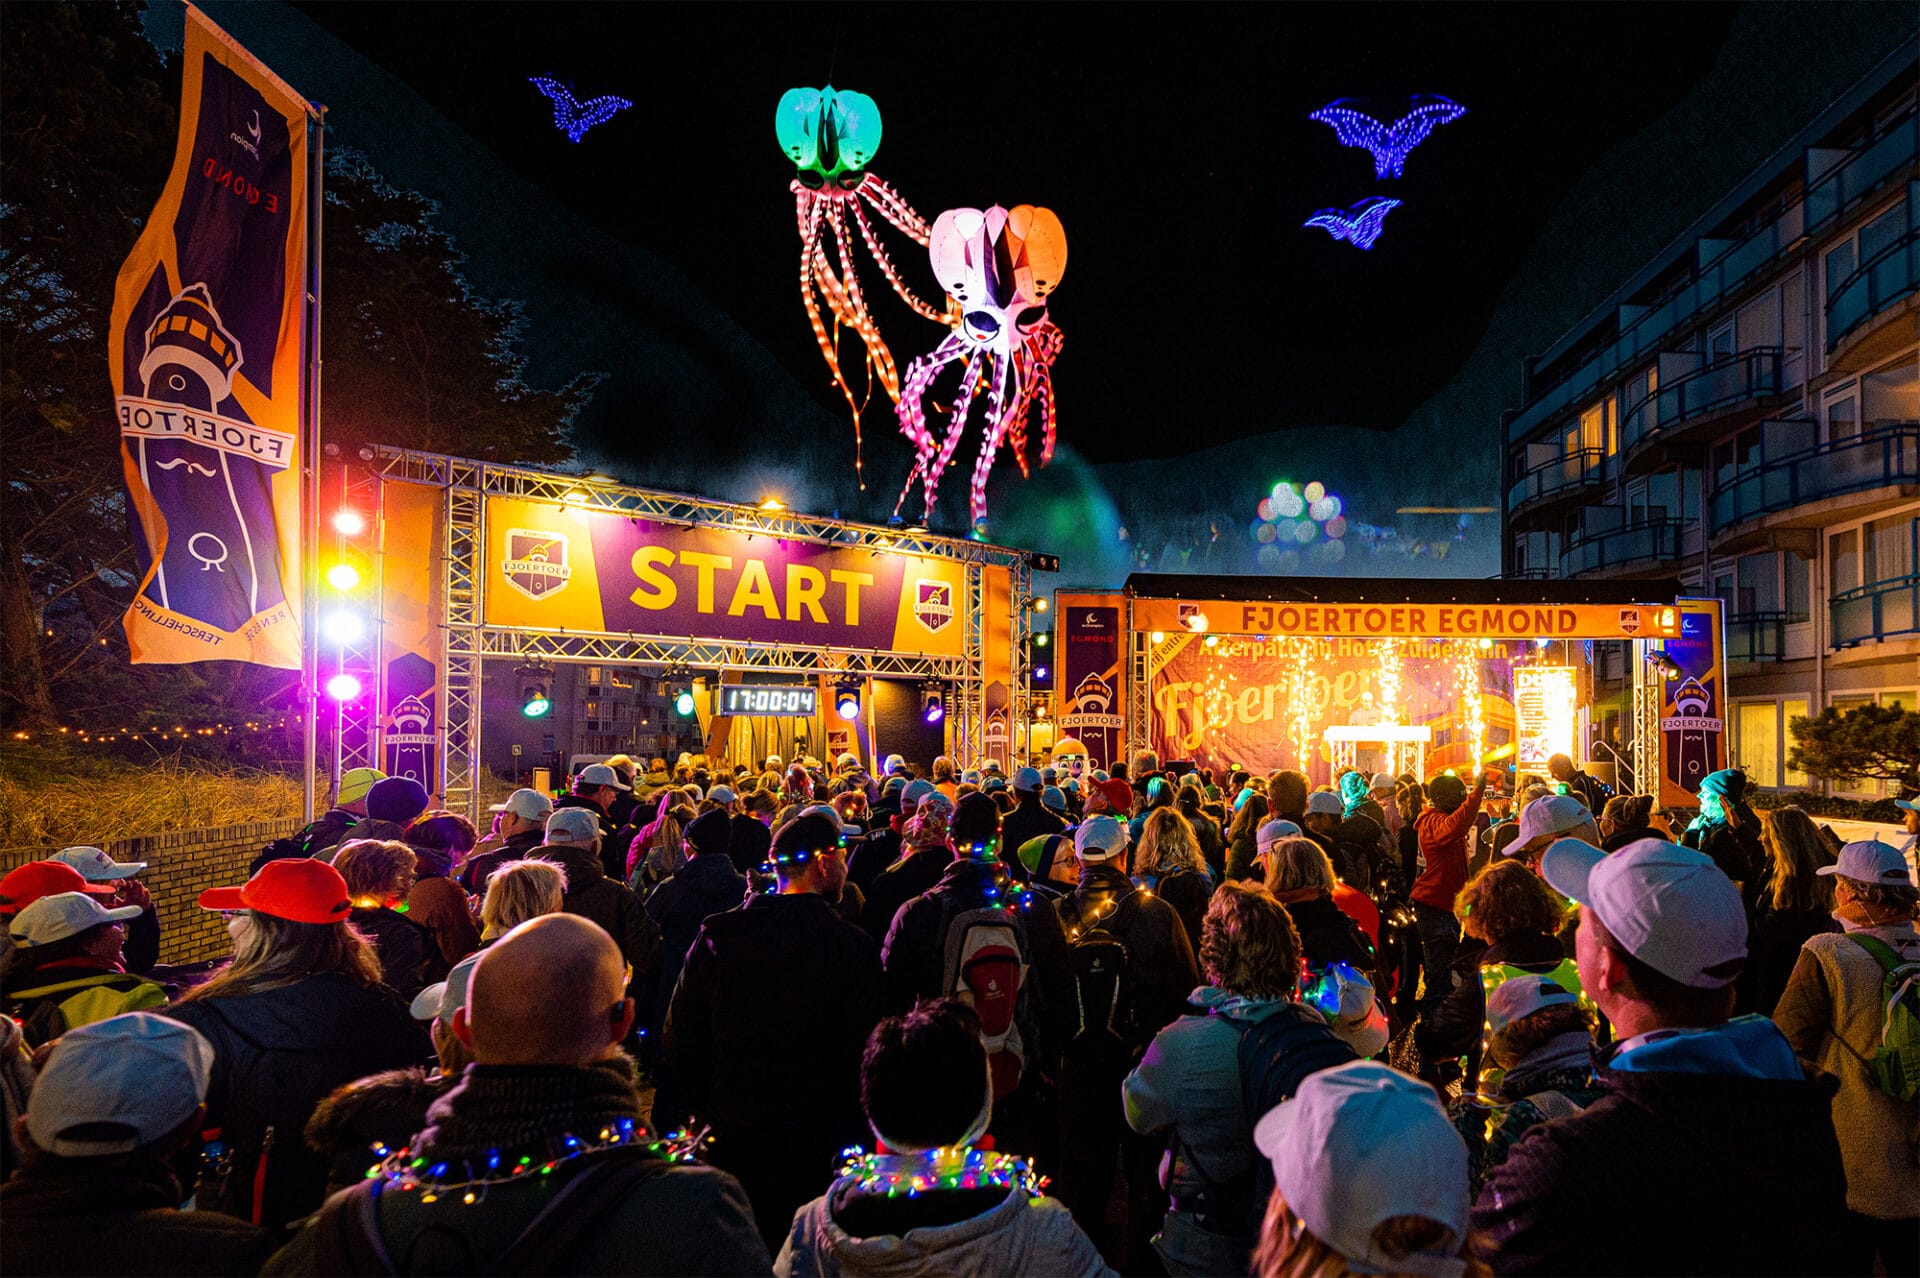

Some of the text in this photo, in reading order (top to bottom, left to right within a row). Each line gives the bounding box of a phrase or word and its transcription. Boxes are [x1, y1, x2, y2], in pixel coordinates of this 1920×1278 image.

[504, 562, 569, 576] FJOERTOER
[629, 545, 874, 626] START
[1243, 606, 1577, 634] FJOERTOER EGMOND
[1071, 635, 1114, 643] EGMOND
[730, 689, 813, 711] 17:00:04
[1061, 716, 1122, 726] FJOERTOER
[1662, 719, 1720, 729] FJOERTOER
[384, 735, 437, 743] FJOERTOER
